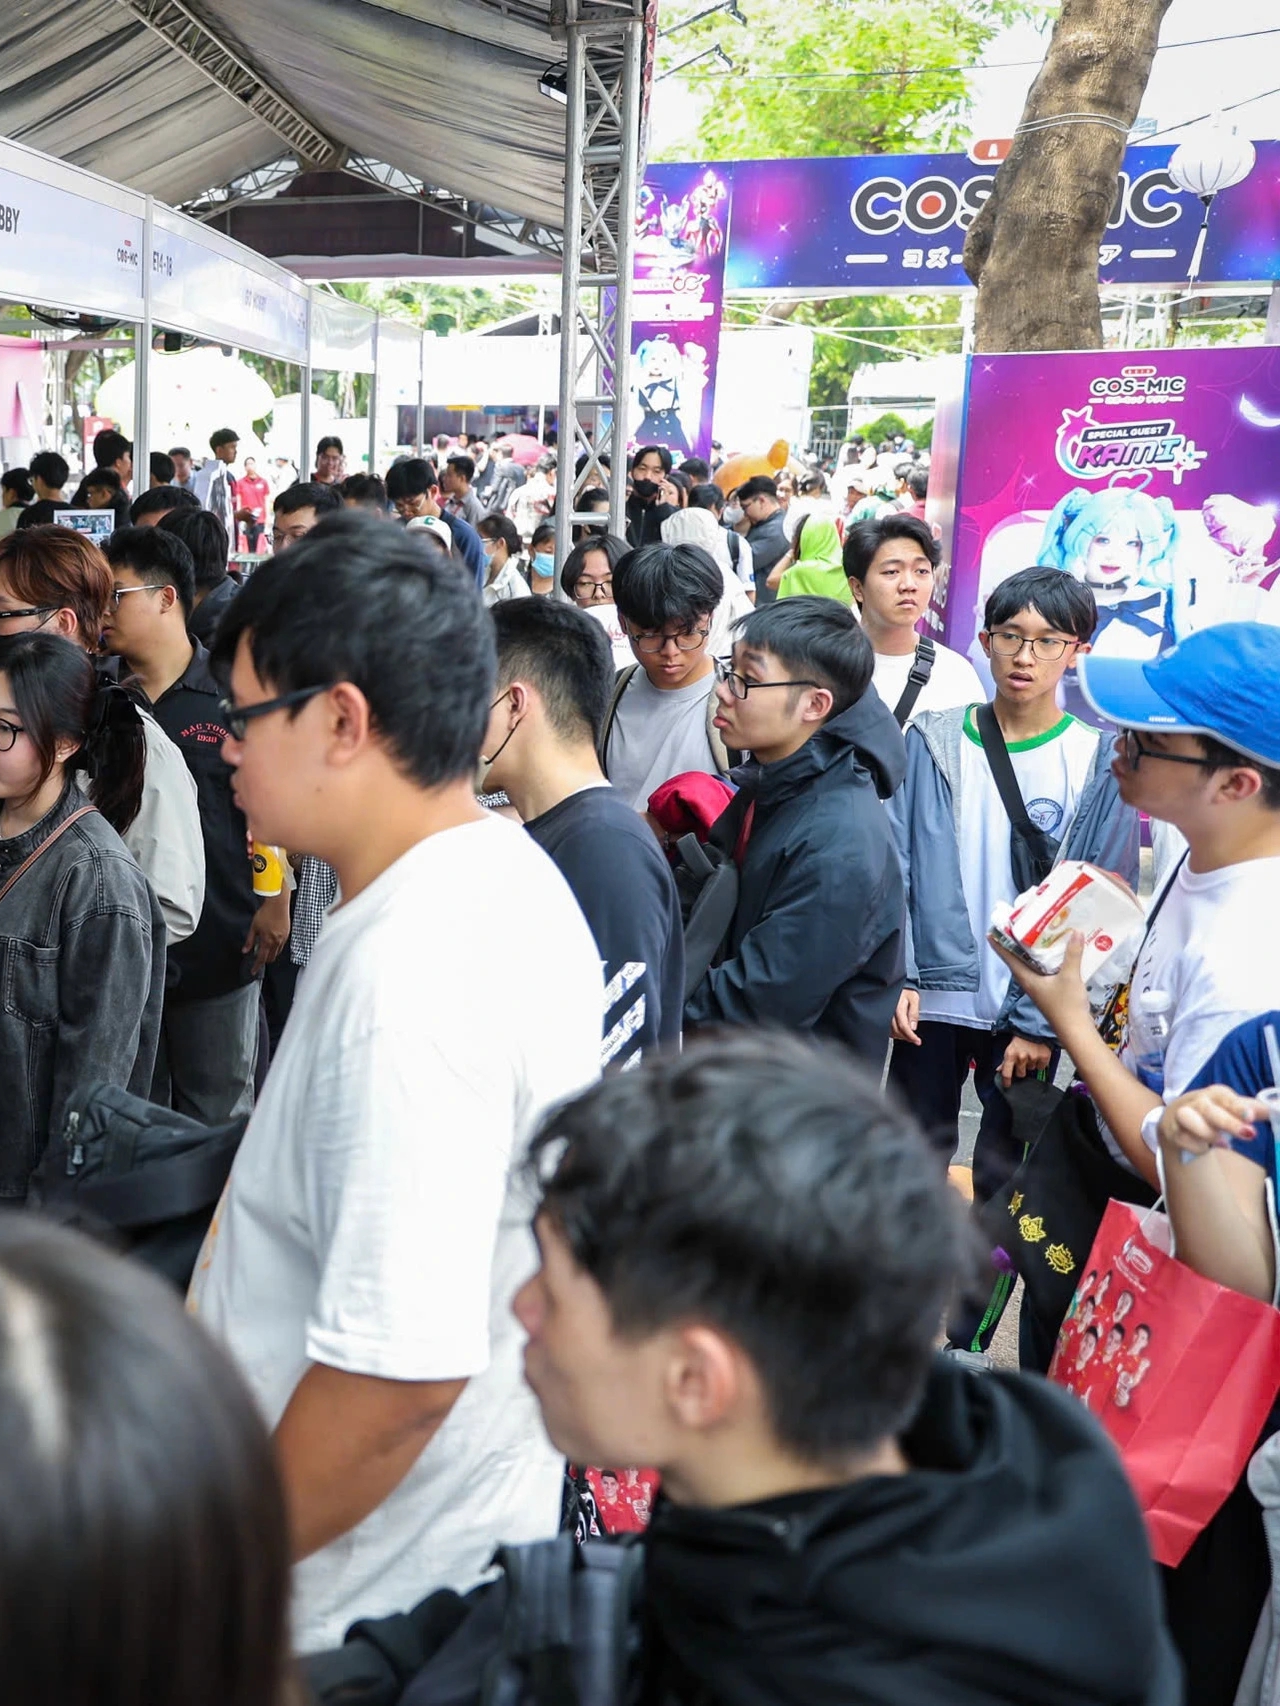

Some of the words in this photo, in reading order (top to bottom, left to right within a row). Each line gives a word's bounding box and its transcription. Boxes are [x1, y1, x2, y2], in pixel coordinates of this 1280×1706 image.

[152, 250, 173, 277] E14-18
[1092, 378, 1184, 394] COS-MIC
[1087, 427, 1129, 440] SPECIAL
[1130, 425, 1165, 437] GUEST
[1075, 438, 1182, 469] KAMI
[180, 723, 203, 737] MAC
